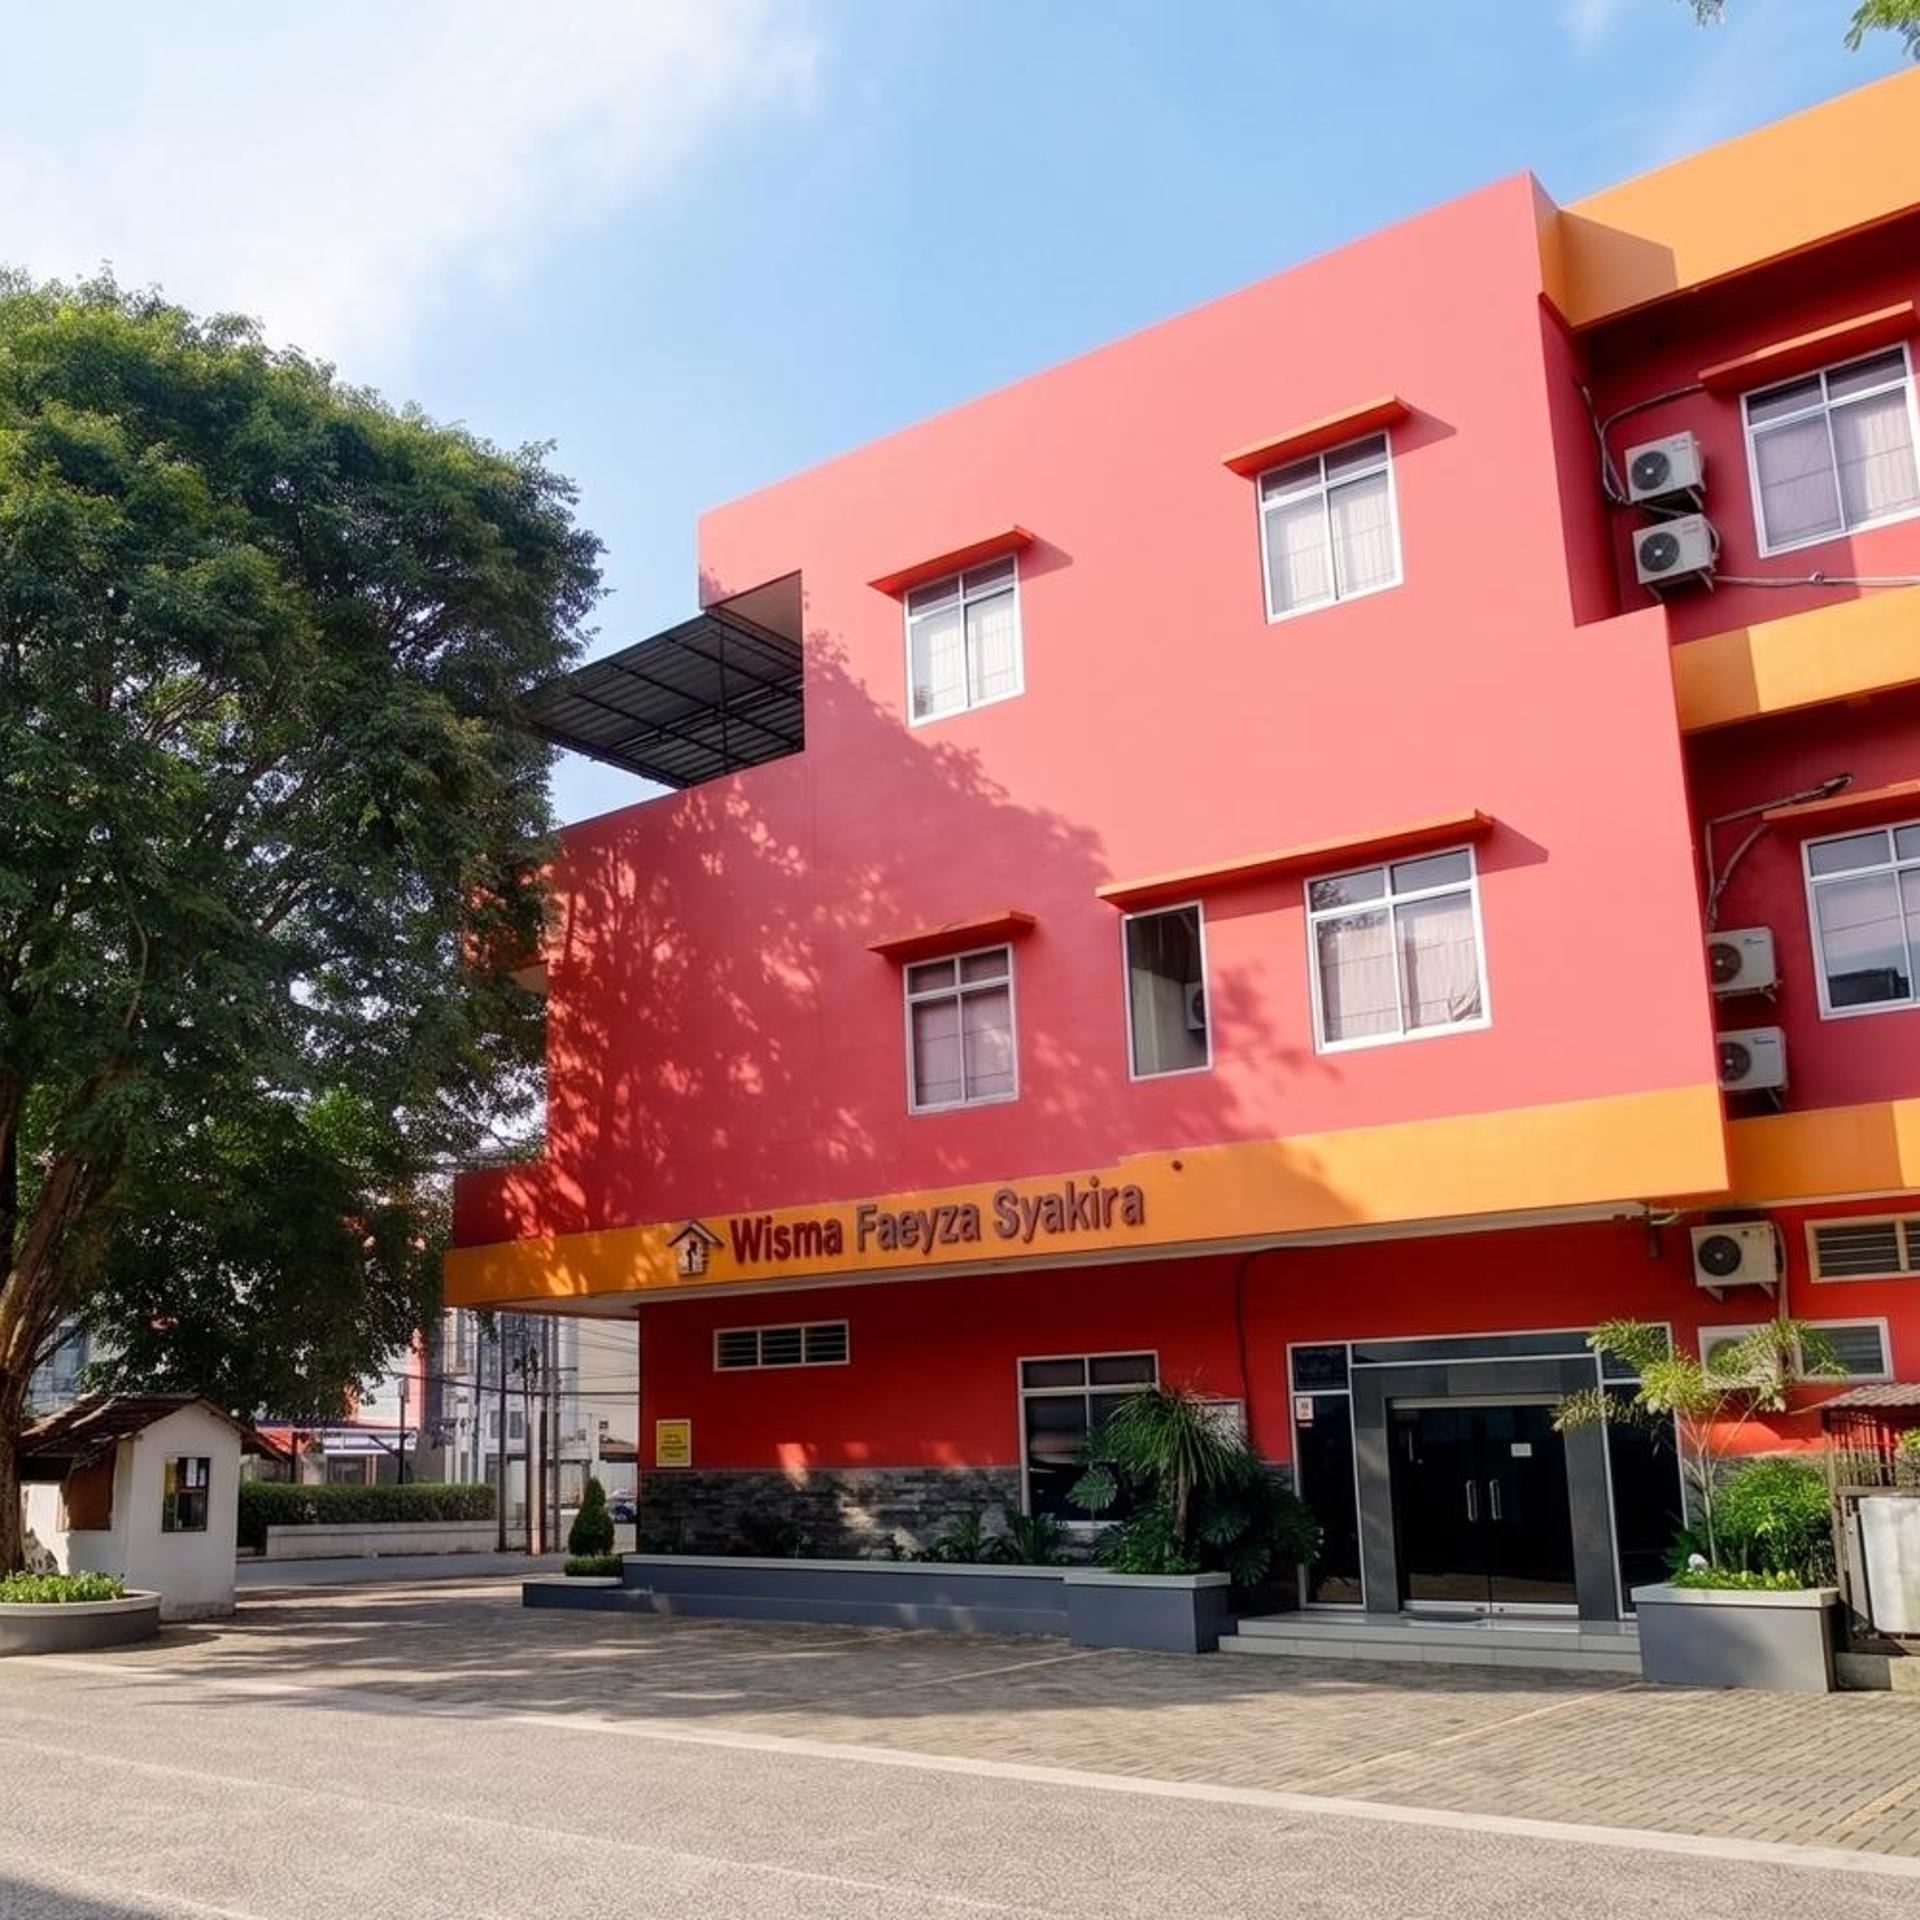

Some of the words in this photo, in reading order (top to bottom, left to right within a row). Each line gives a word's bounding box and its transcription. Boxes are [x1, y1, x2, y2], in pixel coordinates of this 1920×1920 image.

[730, 1215, 843, 1264] Wisma
[856, 1203, 981, 1254] Faeyza
[993, 1176, 1145, 1243] Syakira
